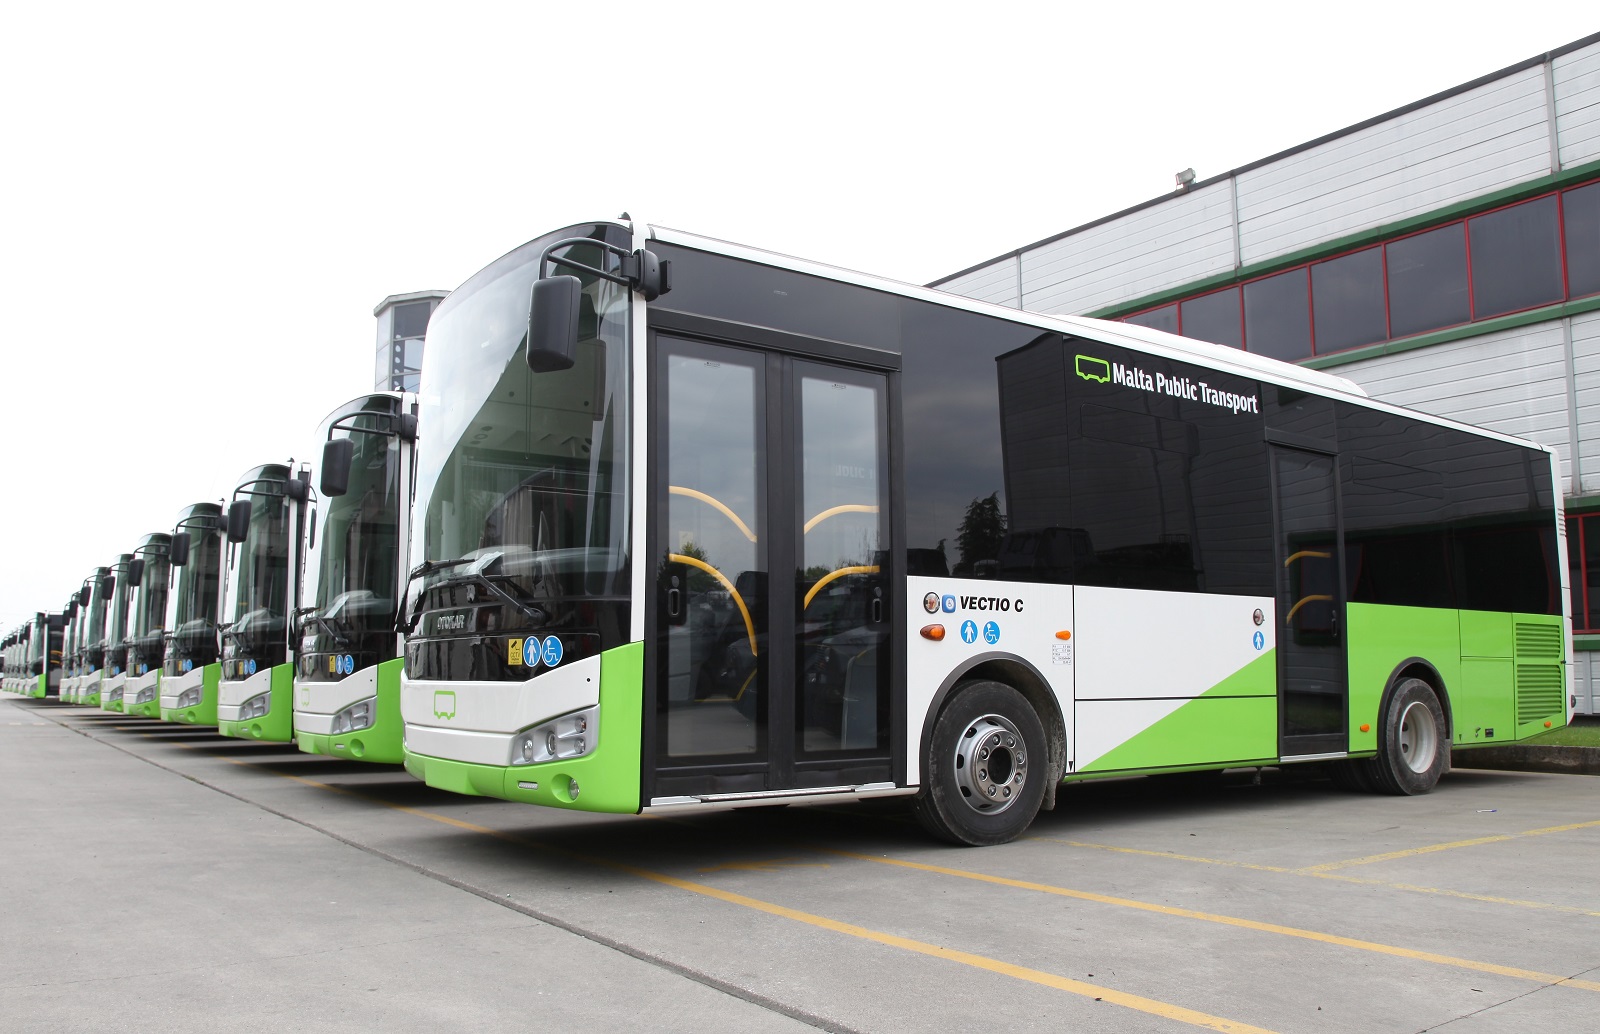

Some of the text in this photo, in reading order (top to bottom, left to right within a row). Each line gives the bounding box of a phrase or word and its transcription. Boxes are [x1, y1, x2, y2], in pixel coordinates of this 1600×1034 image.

[1112, 362, 1259, 415] Malta Public Transport
[960, 595, 1024, 613] VECTIO C
[437, 614, 465, 630] OTOKAR
